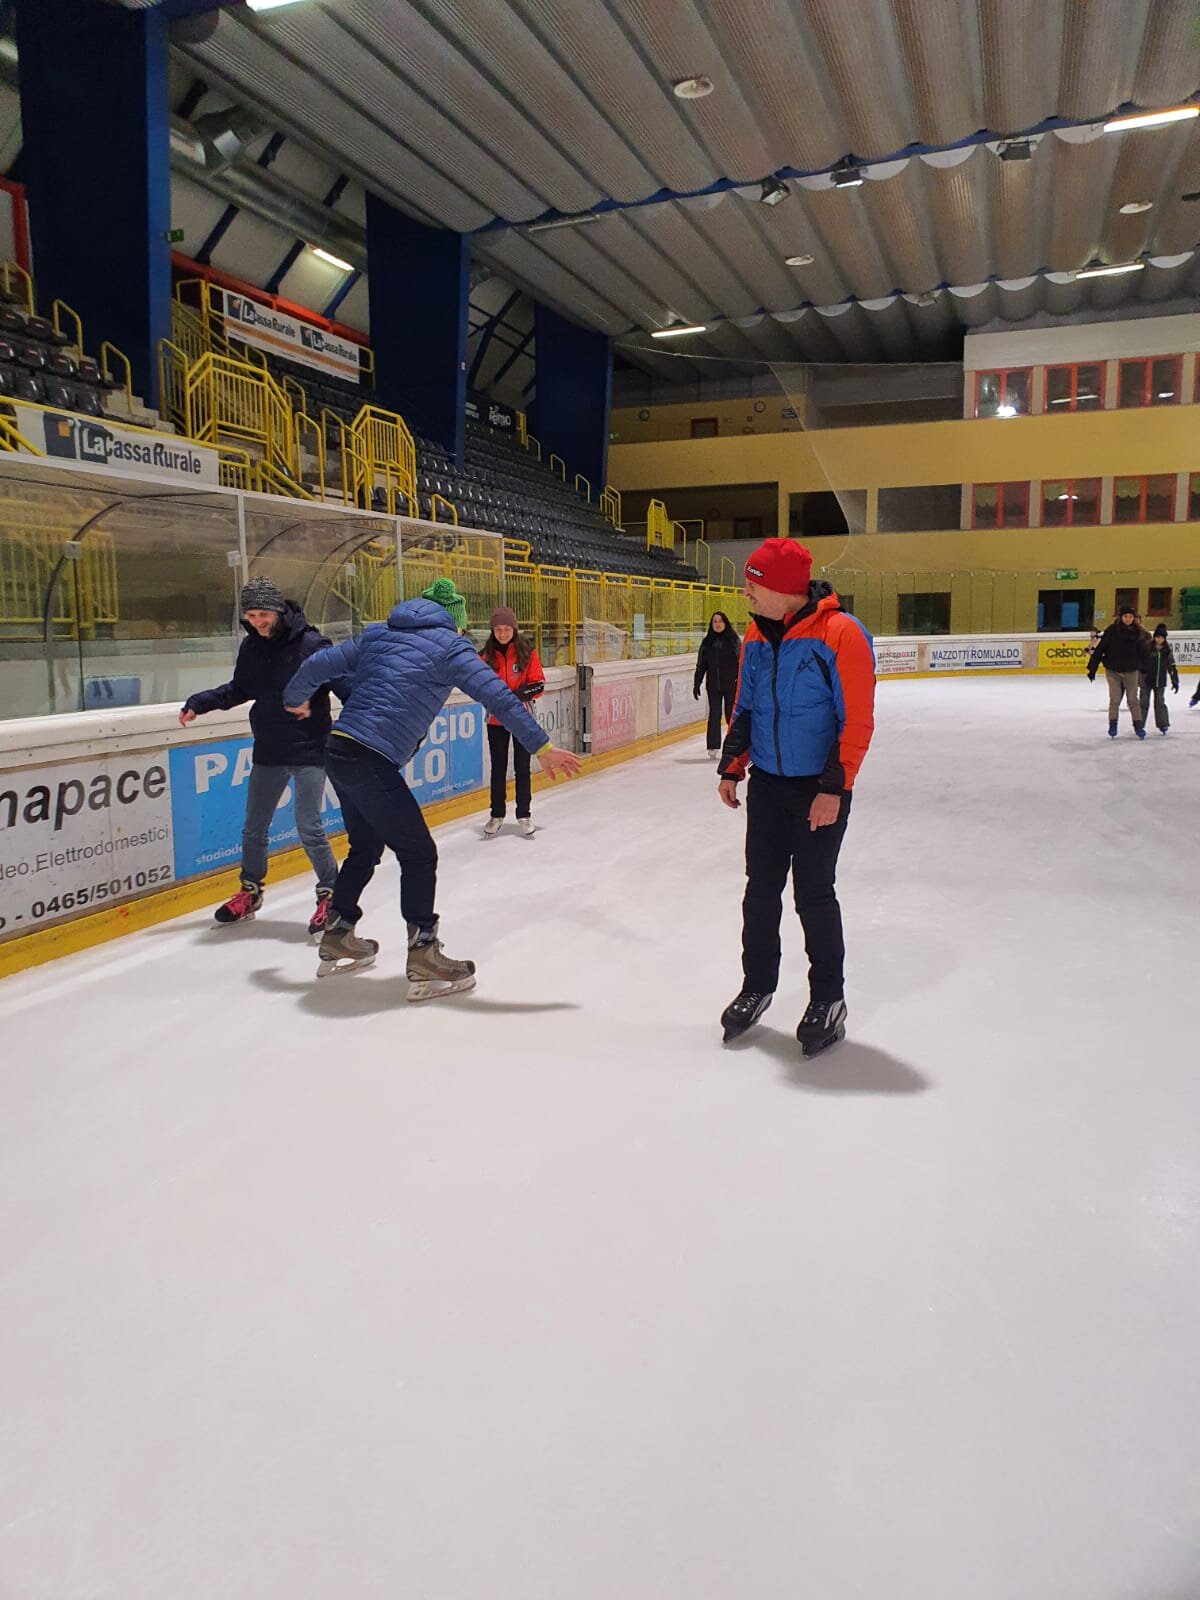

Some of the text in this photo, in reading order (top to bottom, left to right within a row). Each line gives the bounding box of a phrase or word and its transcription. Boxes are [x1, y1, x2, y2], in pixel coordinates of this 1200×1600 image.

[932, 649, 1019, 660] MAZZOTTI ROMUALDO
[31, 864, 171, 918] 0465/501052
